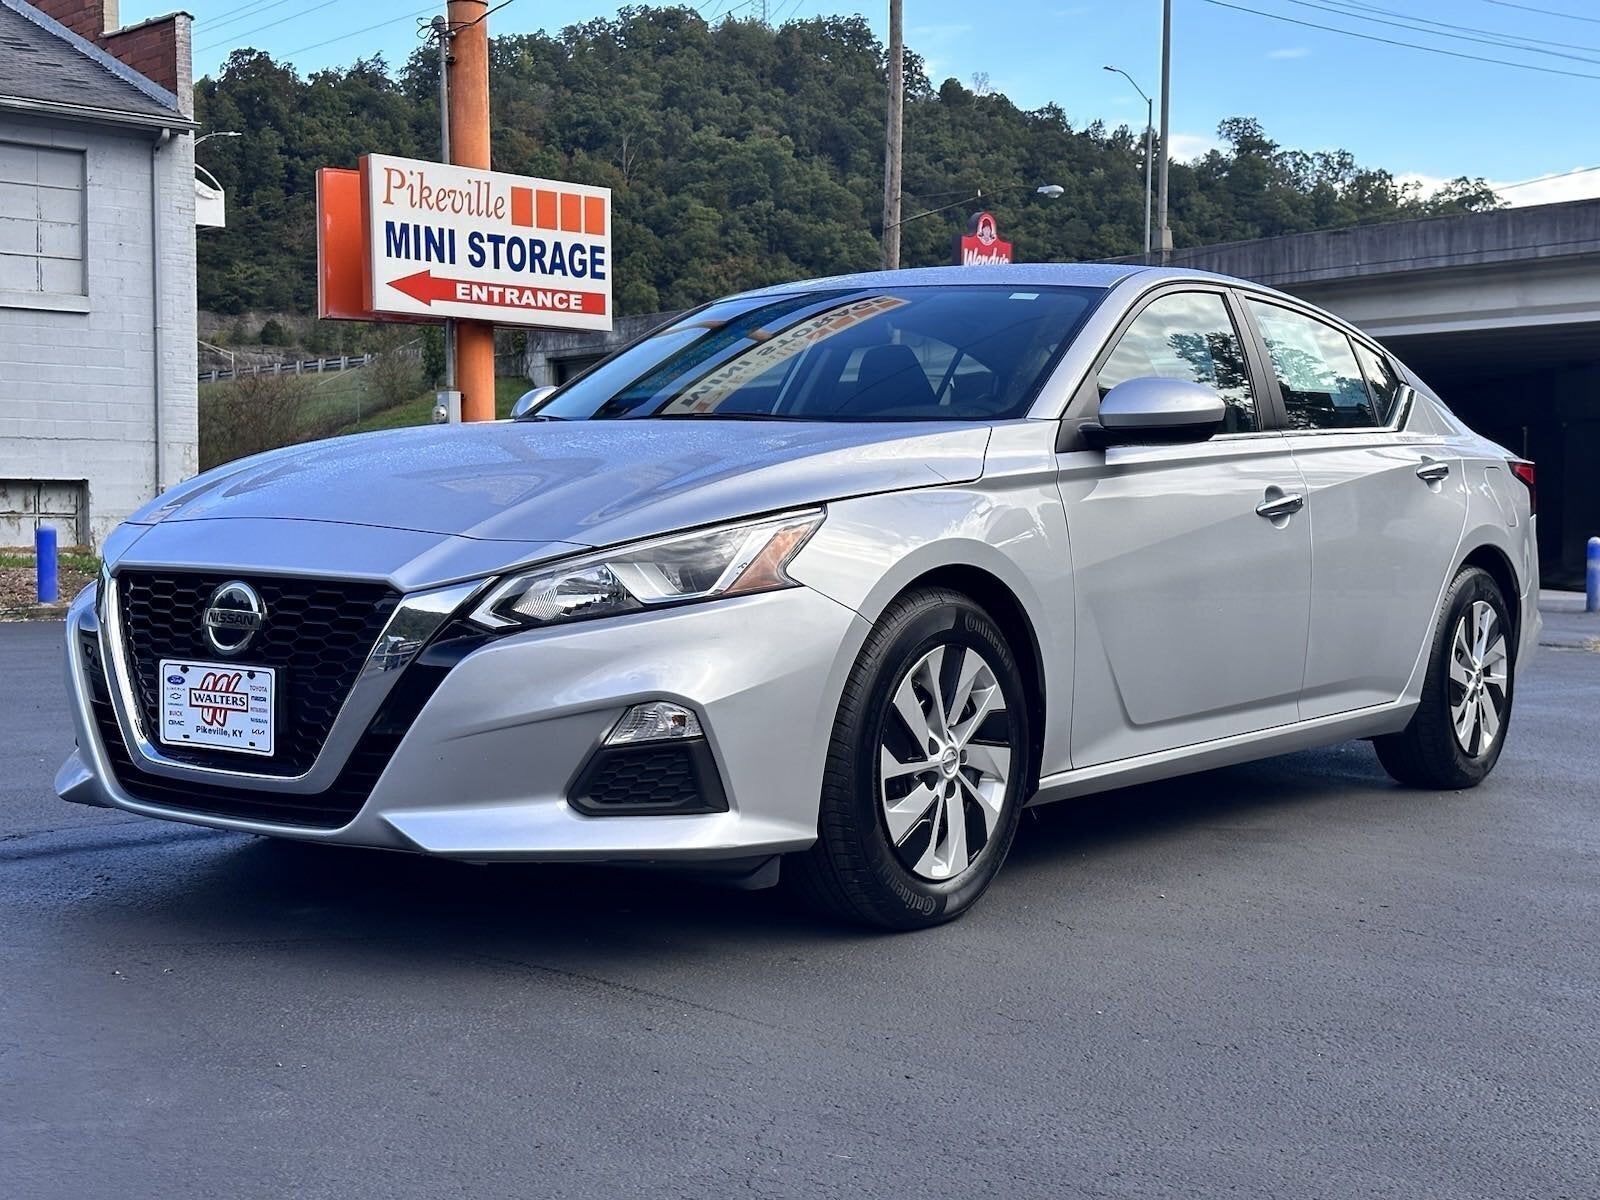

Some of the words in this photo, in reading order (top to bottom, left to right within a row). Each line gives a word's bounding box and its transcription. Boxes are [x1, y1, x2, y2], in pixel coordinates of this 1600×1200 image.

[382, 167, 505, 220] Pikeville
[385, 220, 456, 265] MINI
[467, 231, 606, 280] STORAGE
[455, 283, 583, 311] ENTRANCE
[208, 611, 254, 626] NISSAN
[193, 692, 246, 707] WALTERS
[168, 719, 185, 727] GMC
[195, 725, 231, 738] Pikeville,
[232, 729, 243, 738] KY
